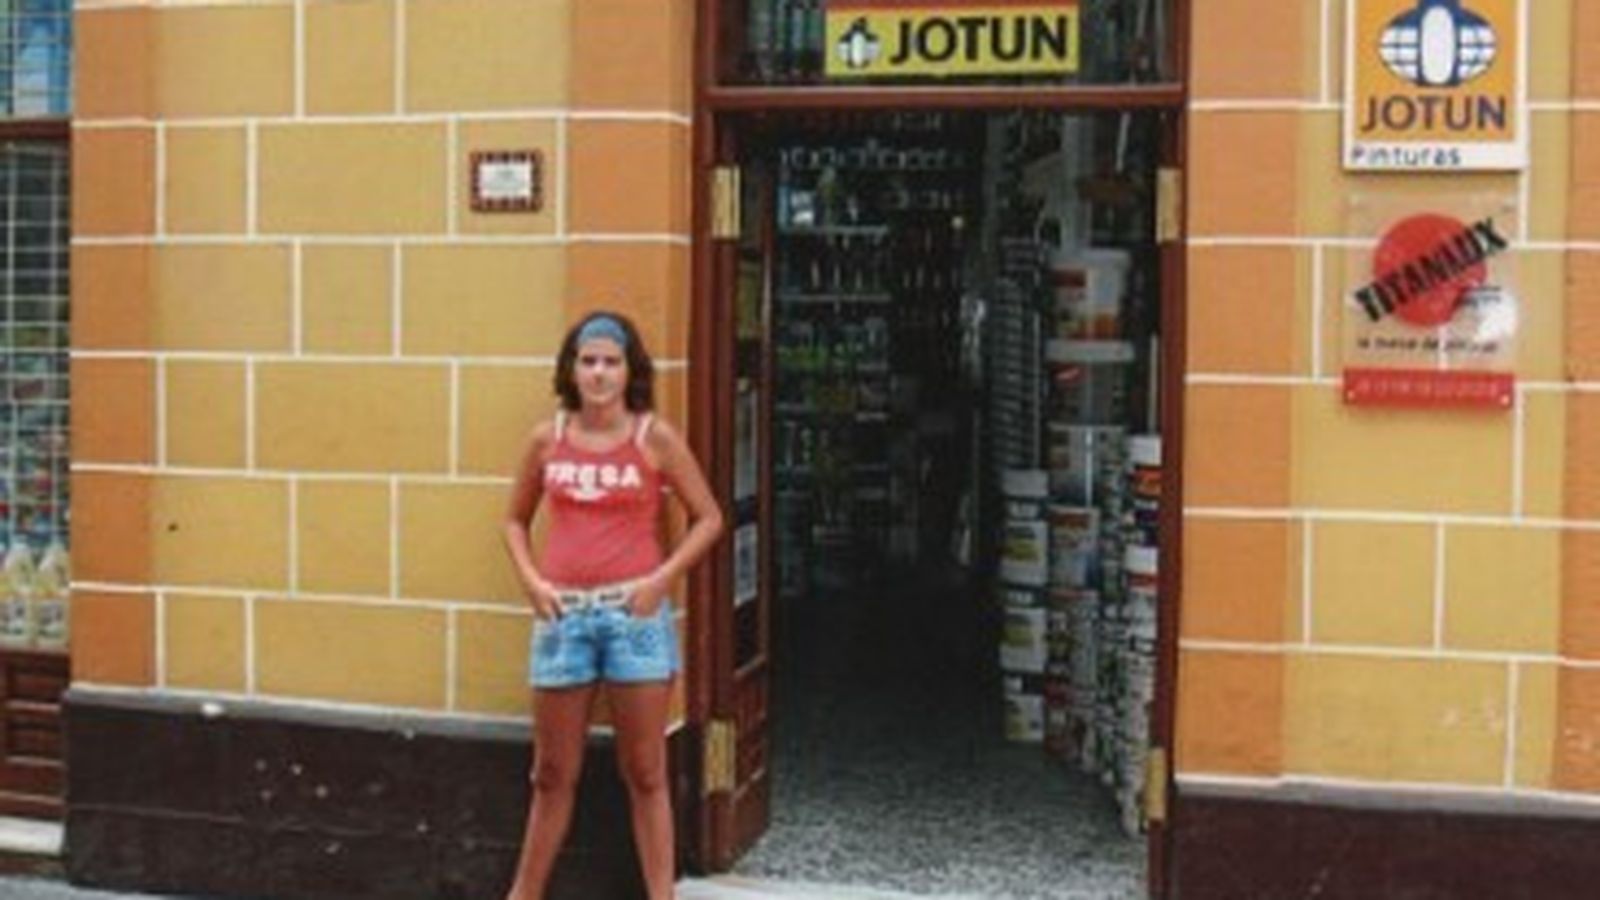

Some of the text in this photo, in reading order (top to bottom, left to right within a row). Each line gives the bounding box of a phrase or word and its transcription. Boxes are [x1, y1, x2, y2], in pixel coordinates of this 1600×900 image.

[890, 16, 1069, 64] JOTUN
[1361, 95, 1506, 133] JOTUN
[1351, 147, 1461, 168] Pinturas
[1355, 217, 1508, 322] TITANLUX
